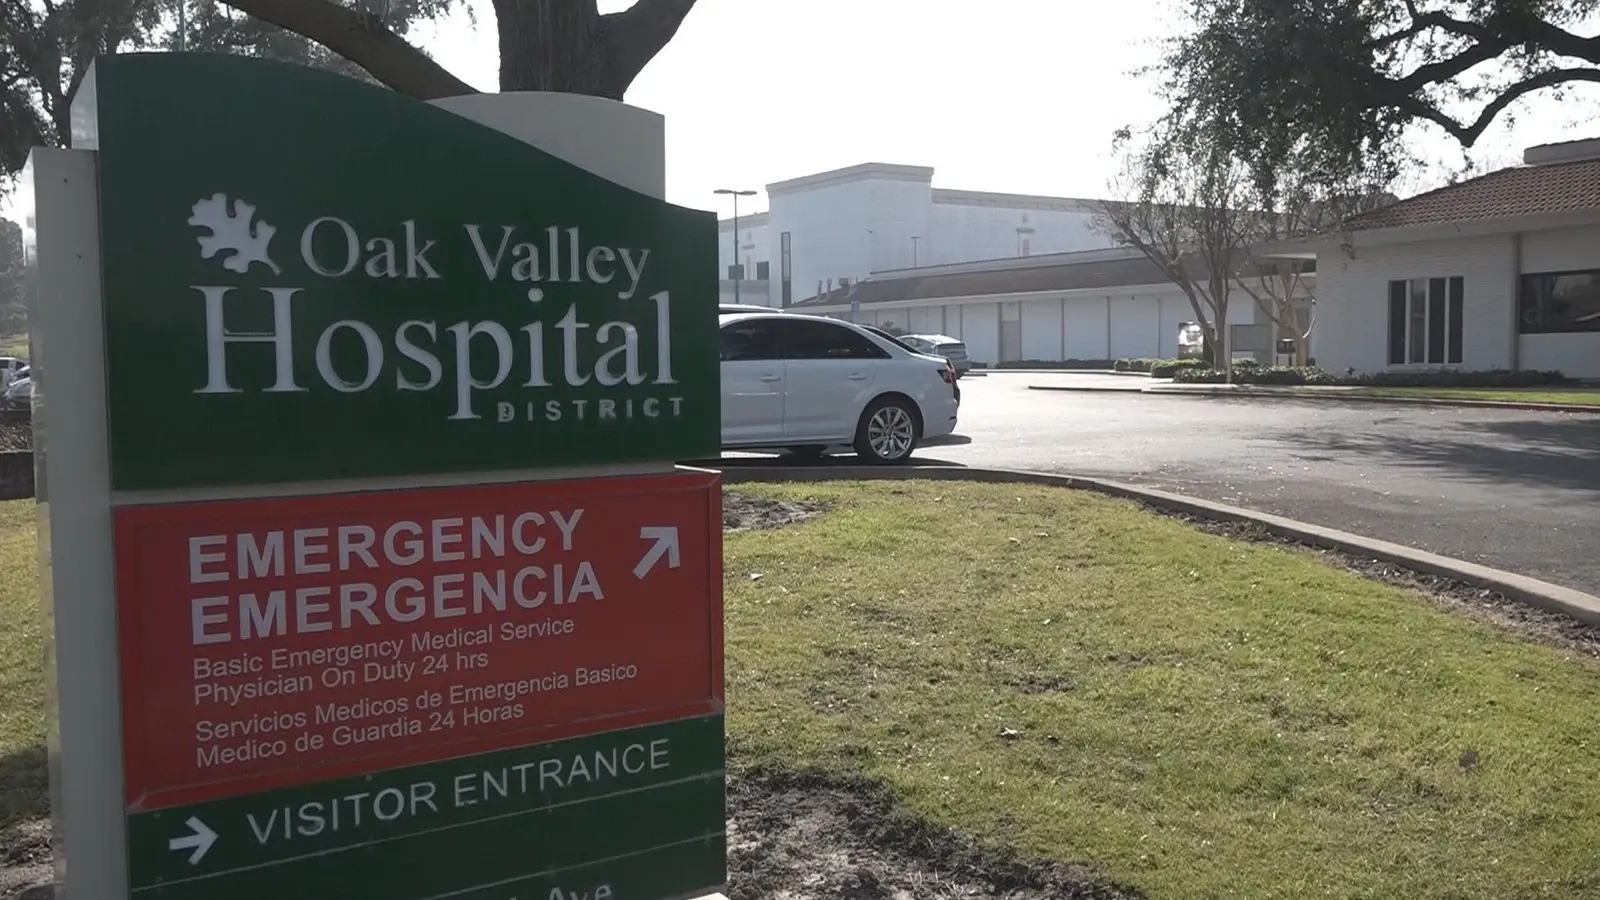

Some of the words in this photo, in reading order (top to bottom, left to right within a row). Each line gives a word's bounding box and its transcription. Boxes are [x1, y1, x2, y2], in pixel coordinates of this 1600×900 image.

[299, 216, 440, 279] Oak
[463, 221, 651, 300] Valley
[190, 285, 678, 421] Hospital
[497, 398, 683, 422] DISTRICT
[189, 509, 584, 584] EMERGENCY
[191, 561, 604, 645] EMERGENCIA
[193, 653, 263, 679] Basic
[271, 639, 404, 669] Emergency
[411, 624, 493, 652] Medical
[500, 618, 575, 641] Service
[194, 674, 313, 705] Physician
[321, 667, 355, 688] On
[364, 660, 416, 682] Duty
[422, 655, 449, 675] 24
[456, 651, 489, 671] hrs
[196, 711, 307, 741] Servicios
[315, 696, 408, 724] Medicos
[416, 691, 443, 709] de
[450, 672, 569, 704] Emergencia
[575, 663, 638, 686] Basico
[197, 738, 287, 768] Medico
[294, 731, 325, 752] de
[332, 715, 422, 746] Guardia
[429, 710, 456, 732] 24
[463, 703, 525, 726] Horas
[246, 780, 437, 845] VISITOR
[454, 738, 670, 808] ENTRANCE
